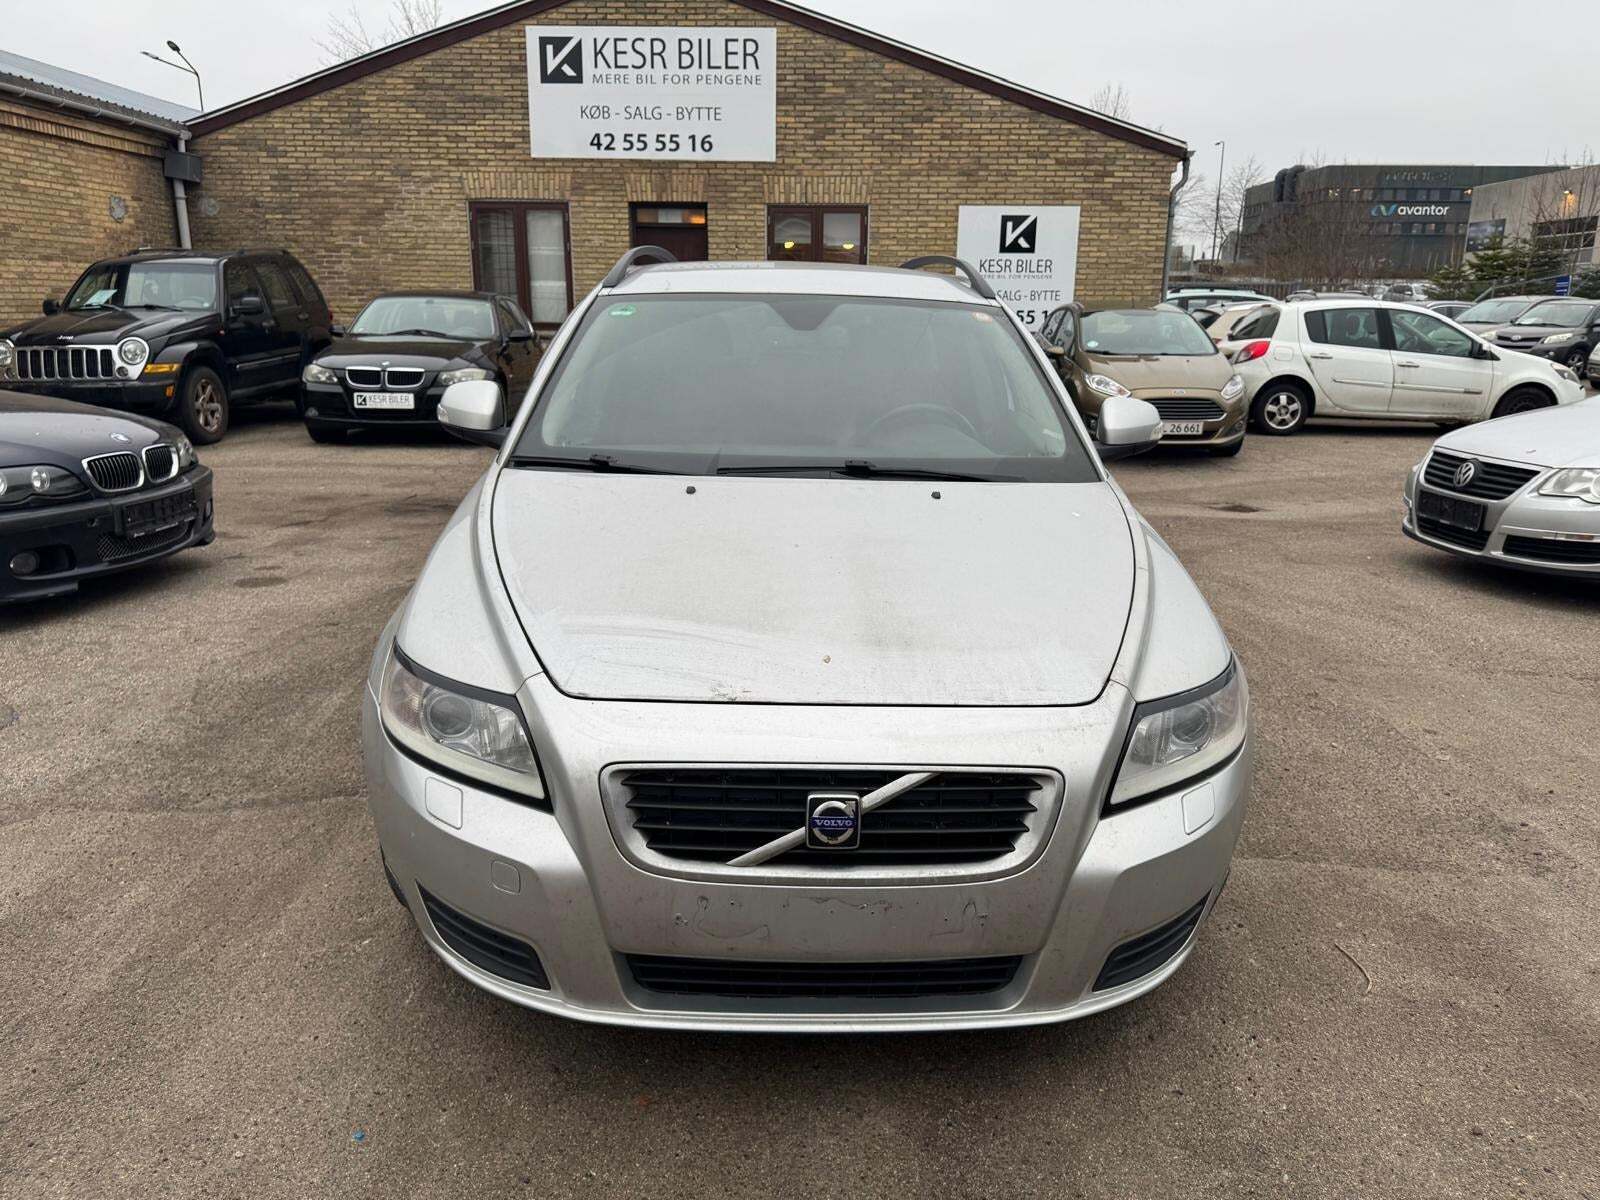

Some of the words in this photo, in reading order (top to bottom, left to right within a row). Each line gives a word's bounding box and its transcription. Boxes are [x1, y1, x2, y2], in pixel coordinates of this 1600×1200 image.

[592, 37, 668, 70] KESR
[677, 38, 760, 71] BILER
[592, 73, 630, 85] MERE
[636, 74, 657, 85] BIL
[663, 74, 690, 85] FOR
[696, 74, 762, 86] PENGENE
[580, 104, 611, 120] KØB
[624, 105, 662, 121] SALG
[676, 106, 722, 122] BYTTE
[589, 132, 616, 151] 42
[623, 133, 648, 152] 55
[655, 133, 680, 152] 55
[688, 134, 713, 153] 16
[1397, 204, 1450, 216] avantor
[979, 259, 1012, 273] KESR
[1015, 259, 1053, 273] BILER
[1030, 290, 1061, 301] BYTTE
[1169, 423, 1182, 433] 26
[1183, 423, 1200, 433] 661
